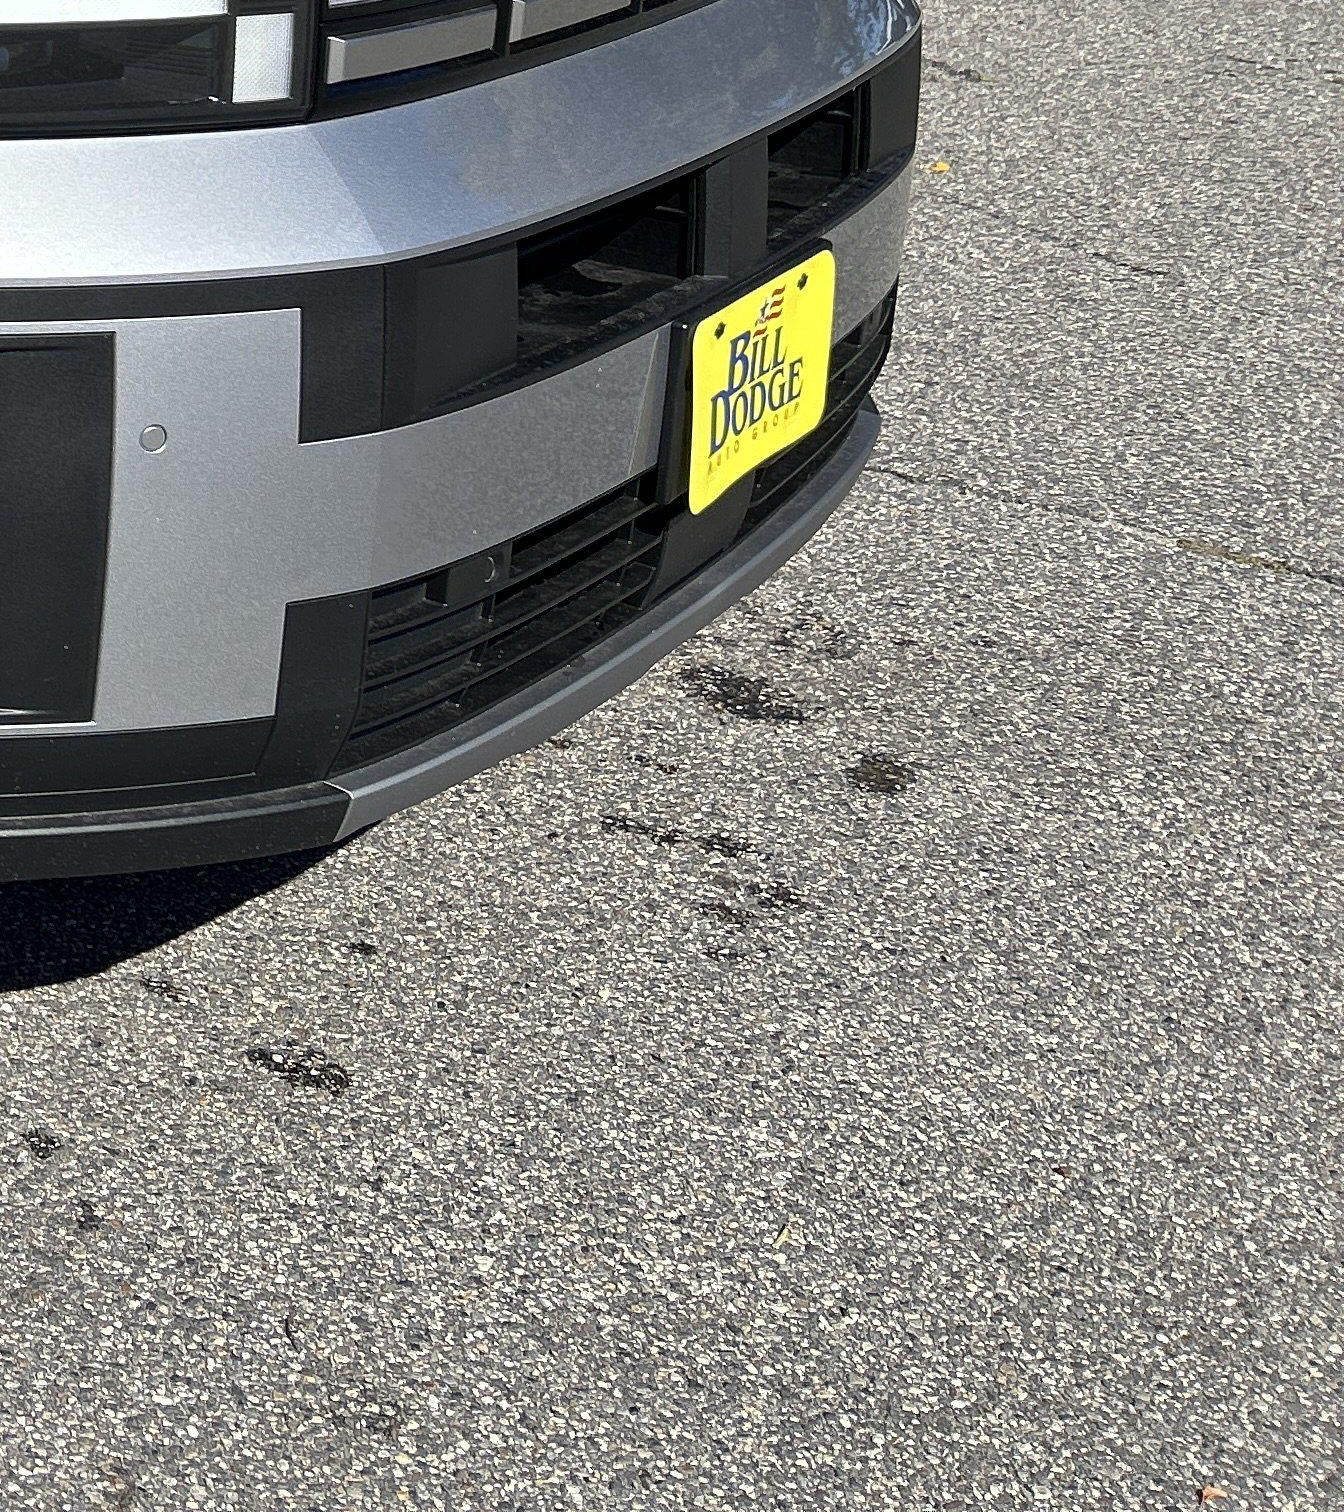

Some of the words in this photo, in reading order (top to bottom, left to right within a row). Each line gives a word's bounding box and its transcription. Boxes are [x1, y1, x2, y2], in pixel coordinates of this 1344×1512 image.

[728, 325, 788, 393] BILL
[707, 441, 740, 474] AUTO
[751, 401, 801, 441] GROUP
[708, 356, 805, 459] DODGE
